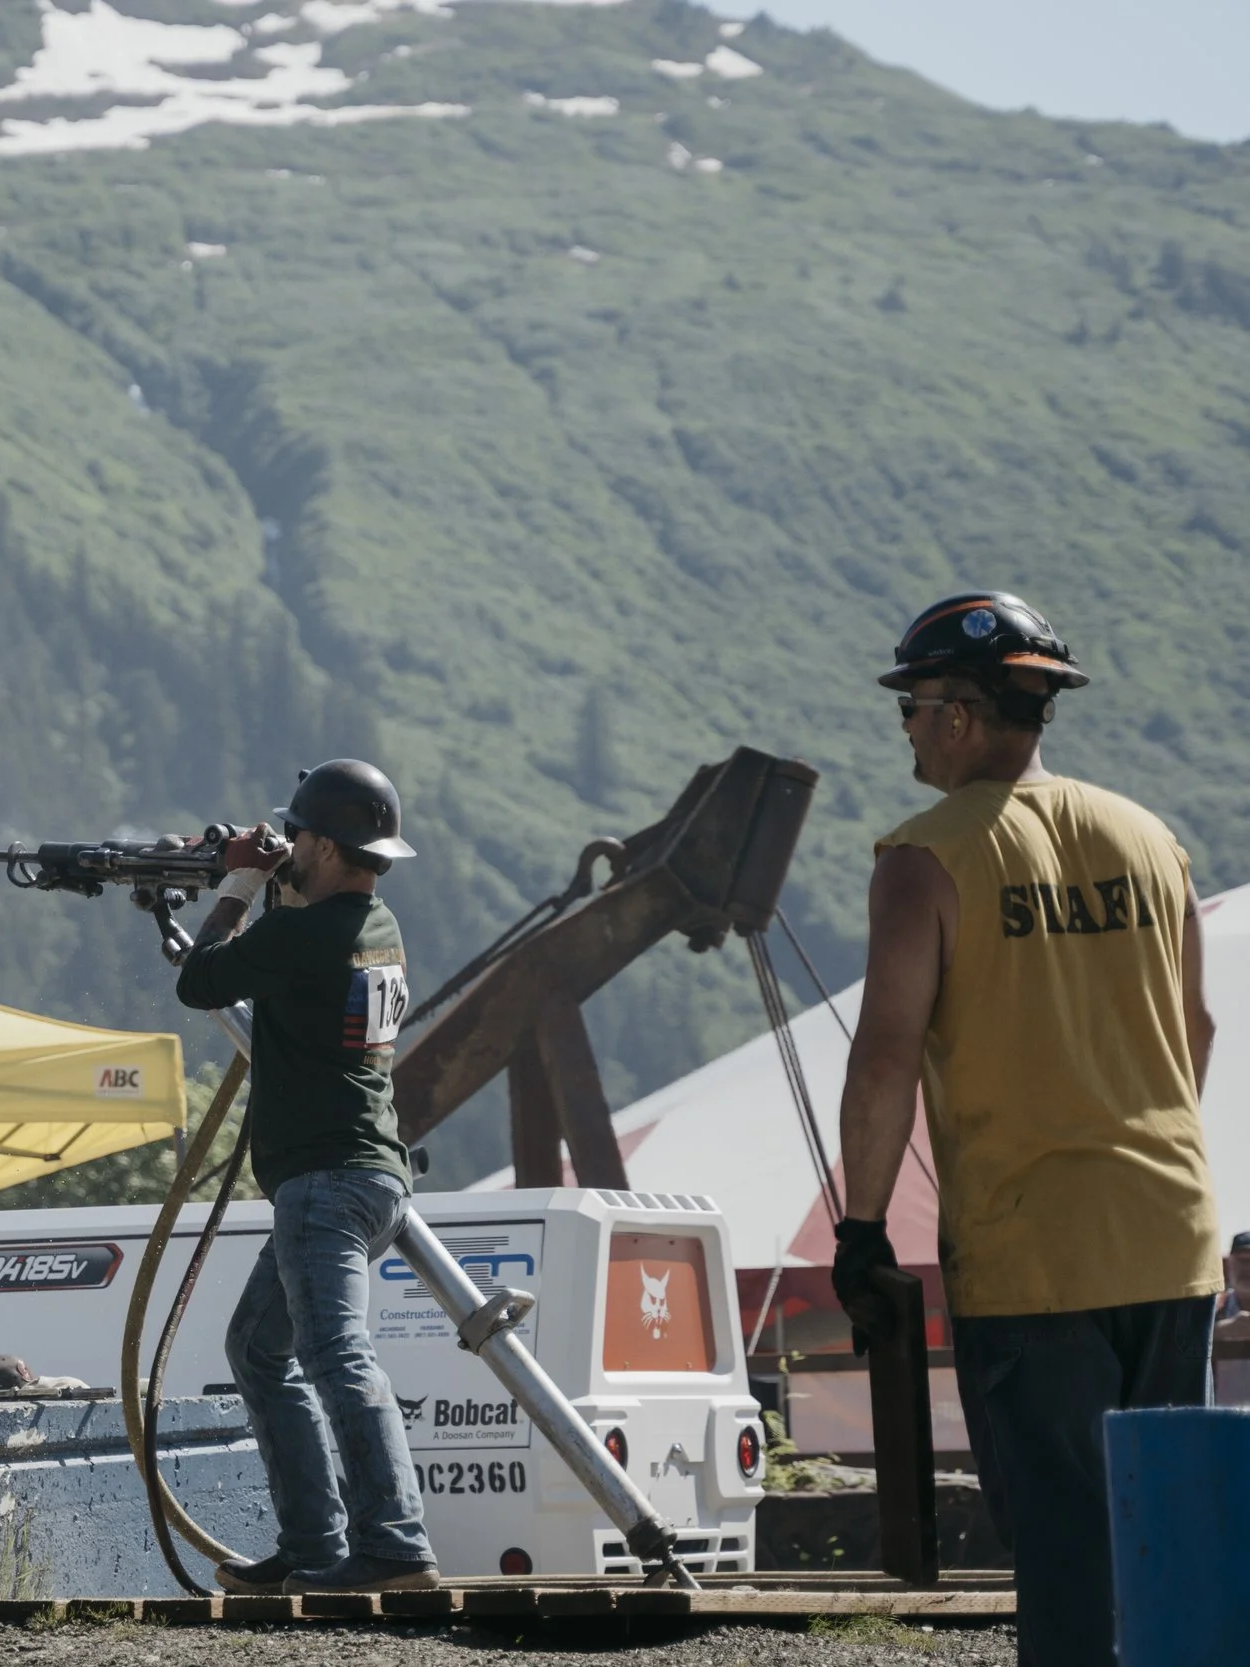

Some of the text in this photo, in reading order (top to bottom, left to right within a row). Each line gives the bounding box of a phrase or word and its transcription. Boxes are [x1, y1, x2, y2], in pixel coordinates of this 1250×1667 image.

[99, 1069, 139, 1088] ABC
[380, 1308, 447, 1321] Construction
[434, 1398, 519, 1427] Bobcat
[433, 1429, 516, 1441] A Doosan Company
